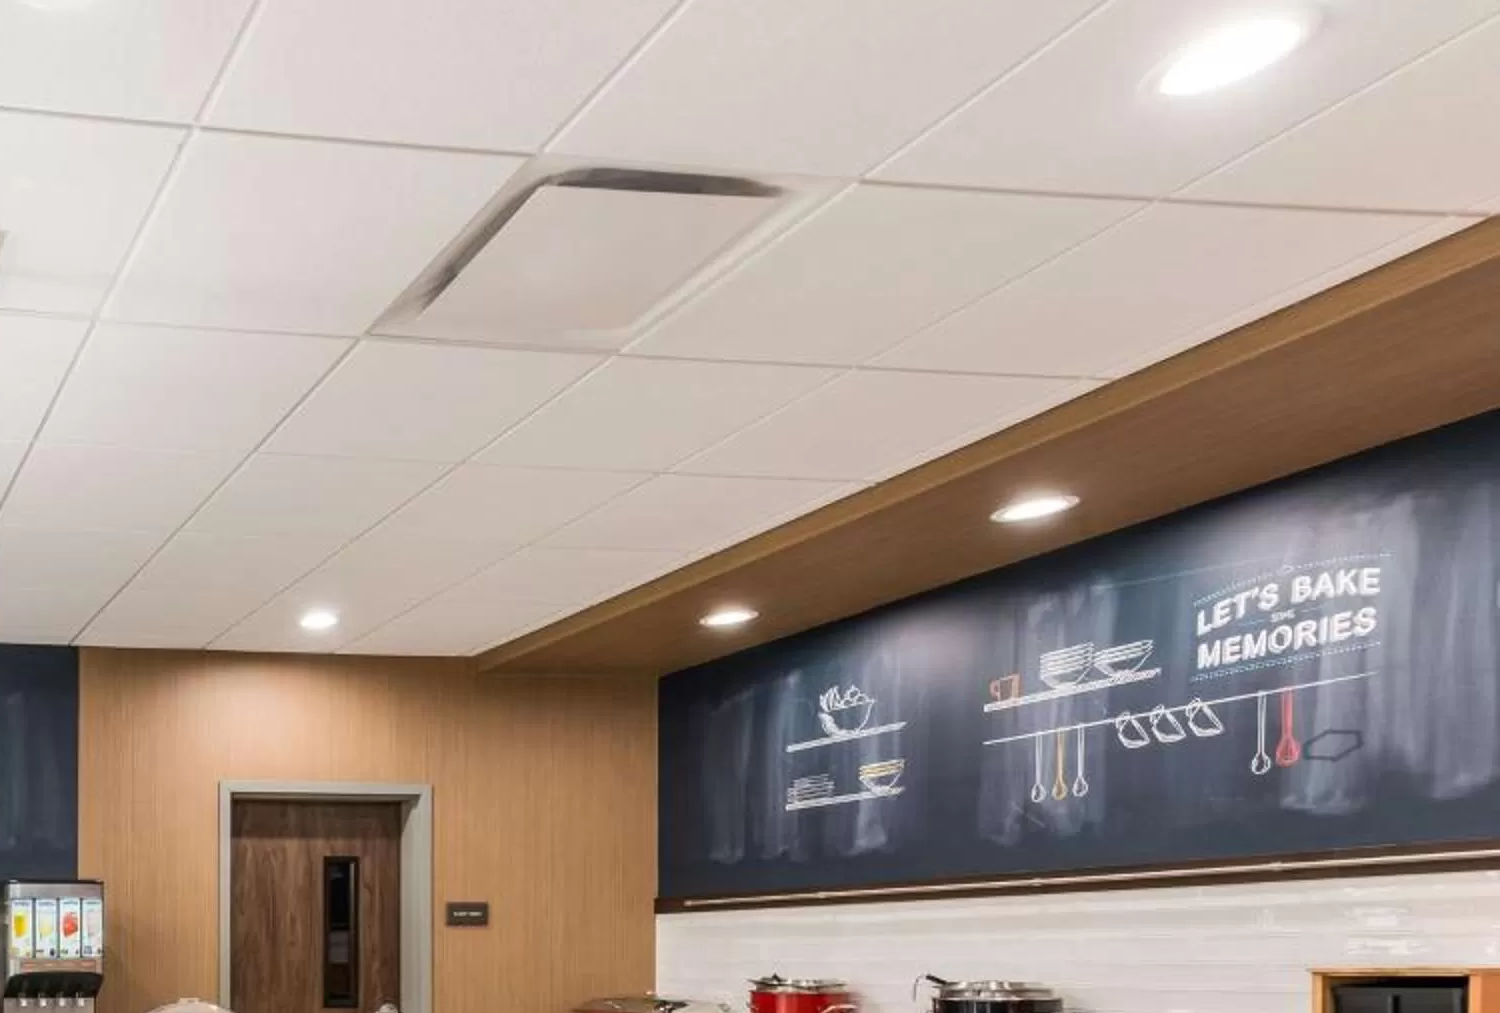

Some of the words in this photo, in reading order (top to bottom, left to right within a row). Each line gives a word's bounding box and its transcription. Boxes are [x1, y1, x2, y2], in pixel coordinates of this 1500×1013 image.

[1195, 582, 1280, 637] LET'S
[1290, 566, 1382, 604] BAKE
[1196, 605, 1378, 670] MEMORIES
